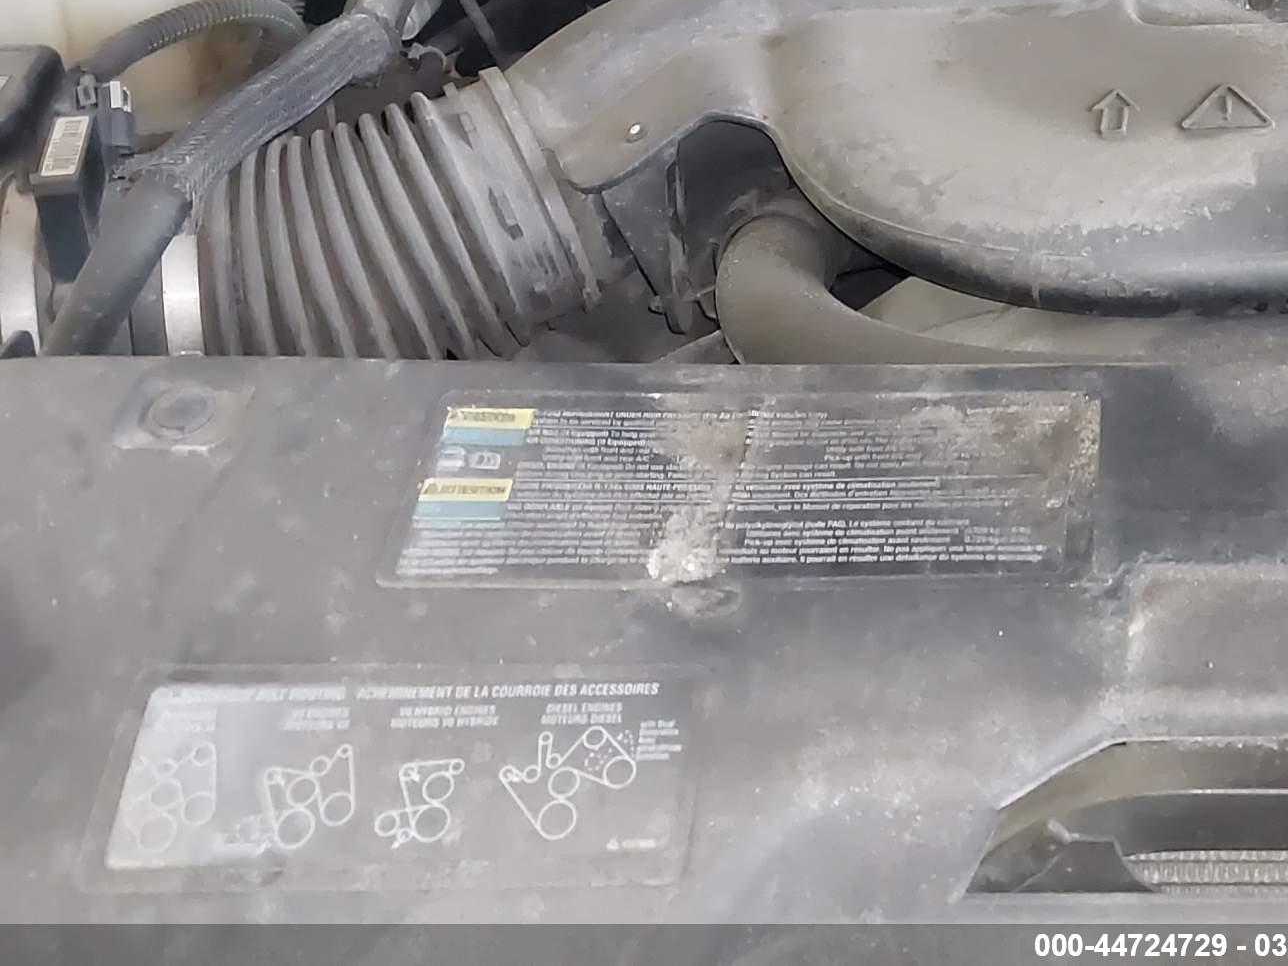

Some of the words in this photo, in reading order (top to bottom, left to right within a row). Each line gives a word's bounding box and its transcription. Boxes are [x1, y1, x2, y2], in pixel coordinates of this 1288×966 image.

[454, 685, 472, 698] DE
[473, 685, 489, 698] LA
[492, 684, 551, 697] COURROIE
[553, 683, 577, 696] DES
[579, 682, 661, 696] ACCESSOIRES
[545, 703, 578, 714] DIESEL
